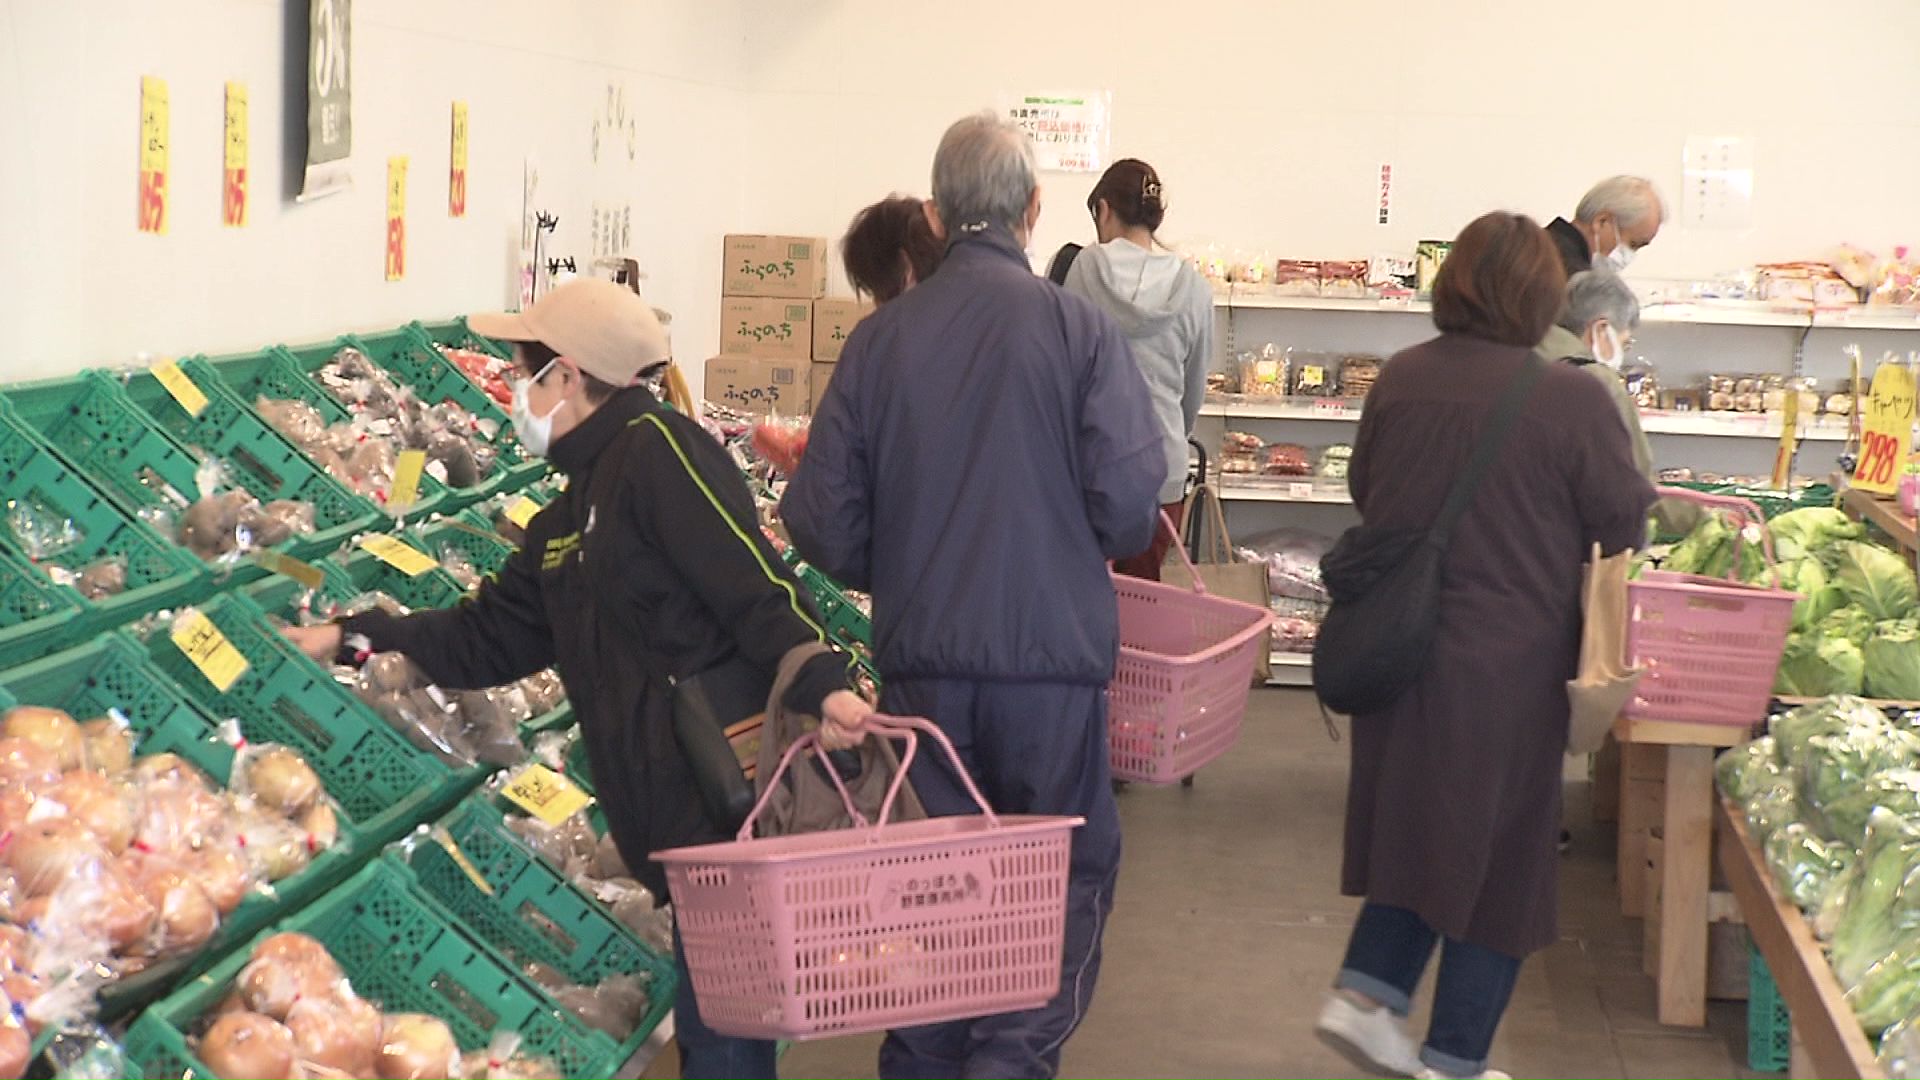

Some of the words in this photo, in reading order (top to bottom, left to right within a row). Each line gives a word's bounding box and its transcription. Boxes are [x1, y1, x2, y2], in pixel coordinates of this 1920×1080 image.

[740, 260, 795, 280] ふらのっち
[737, 321, 792, 341] ふらのっち
[724, 384, 780, 405] ふらのっち
[1855, 430, 1898, 485] 298
